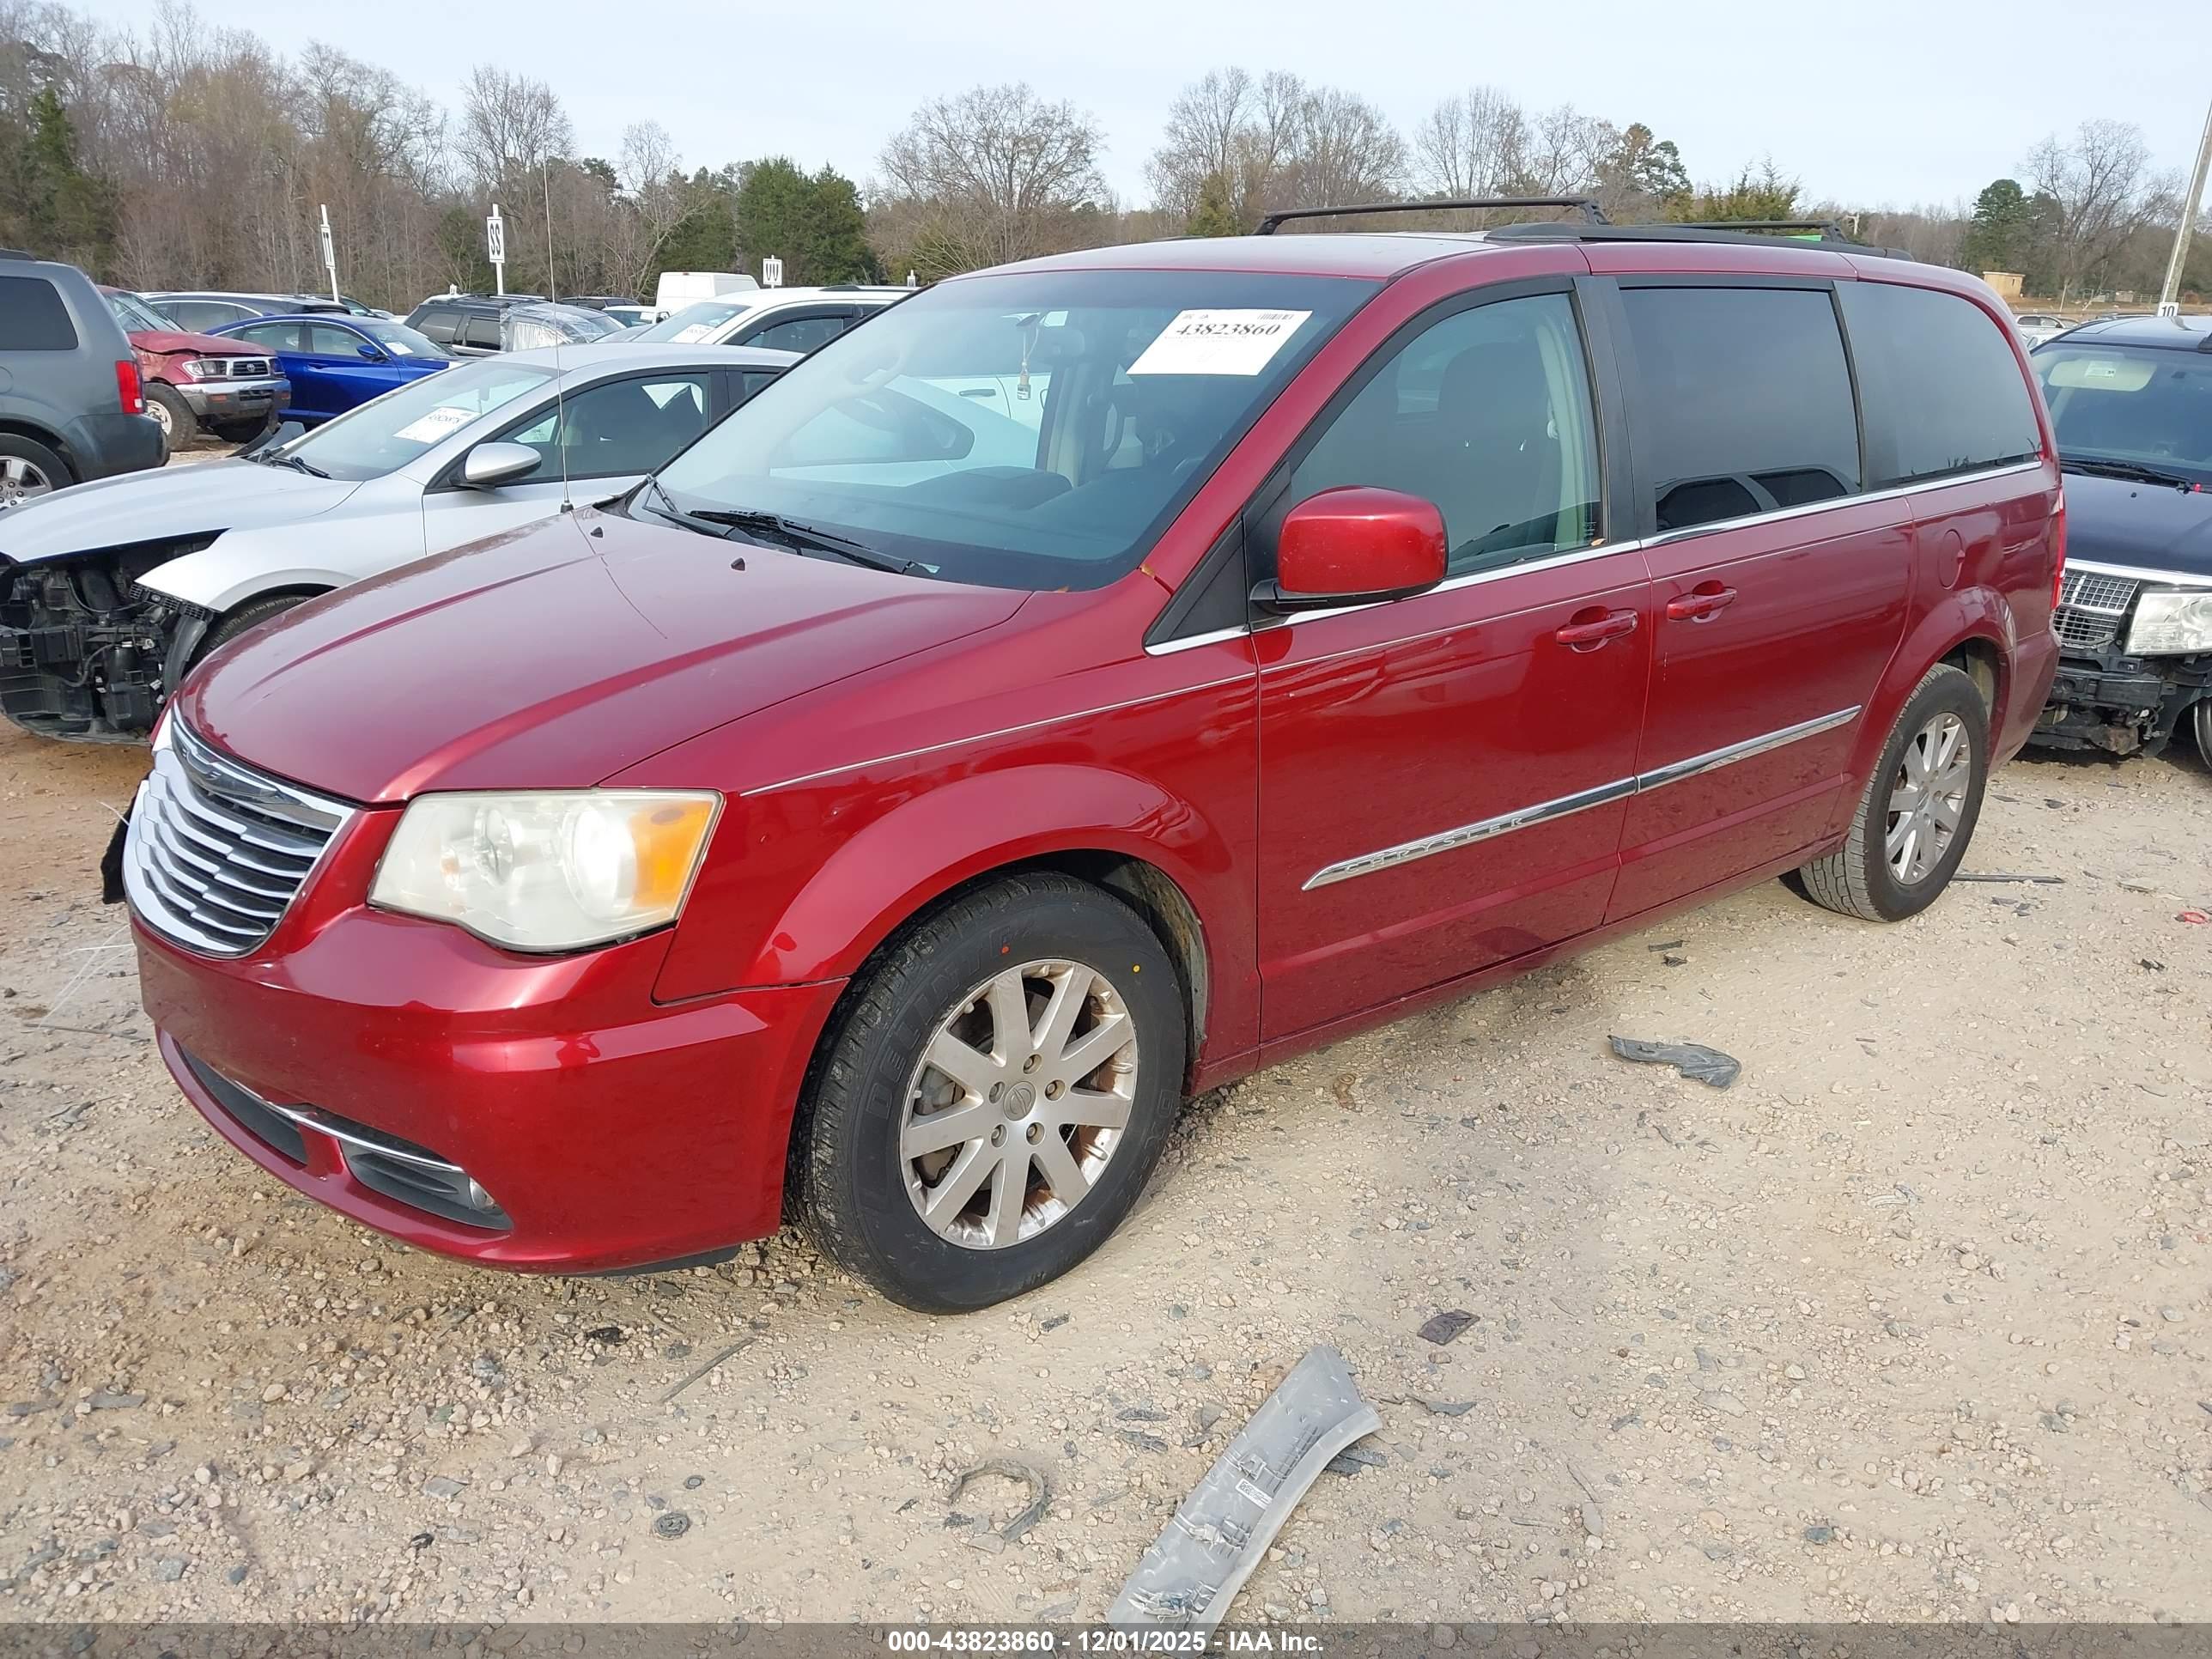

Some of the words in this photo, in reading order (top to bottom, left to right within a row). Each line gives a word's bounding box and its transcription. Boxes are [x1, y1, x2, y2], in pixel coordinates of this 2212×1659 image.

[489, 222, 501, 255] SS
[2161, 305, 2175, 317] 10
[1176, 323, 1281, 336] 43823860
[1345, 817, 1523, 875] CHRYSLER
